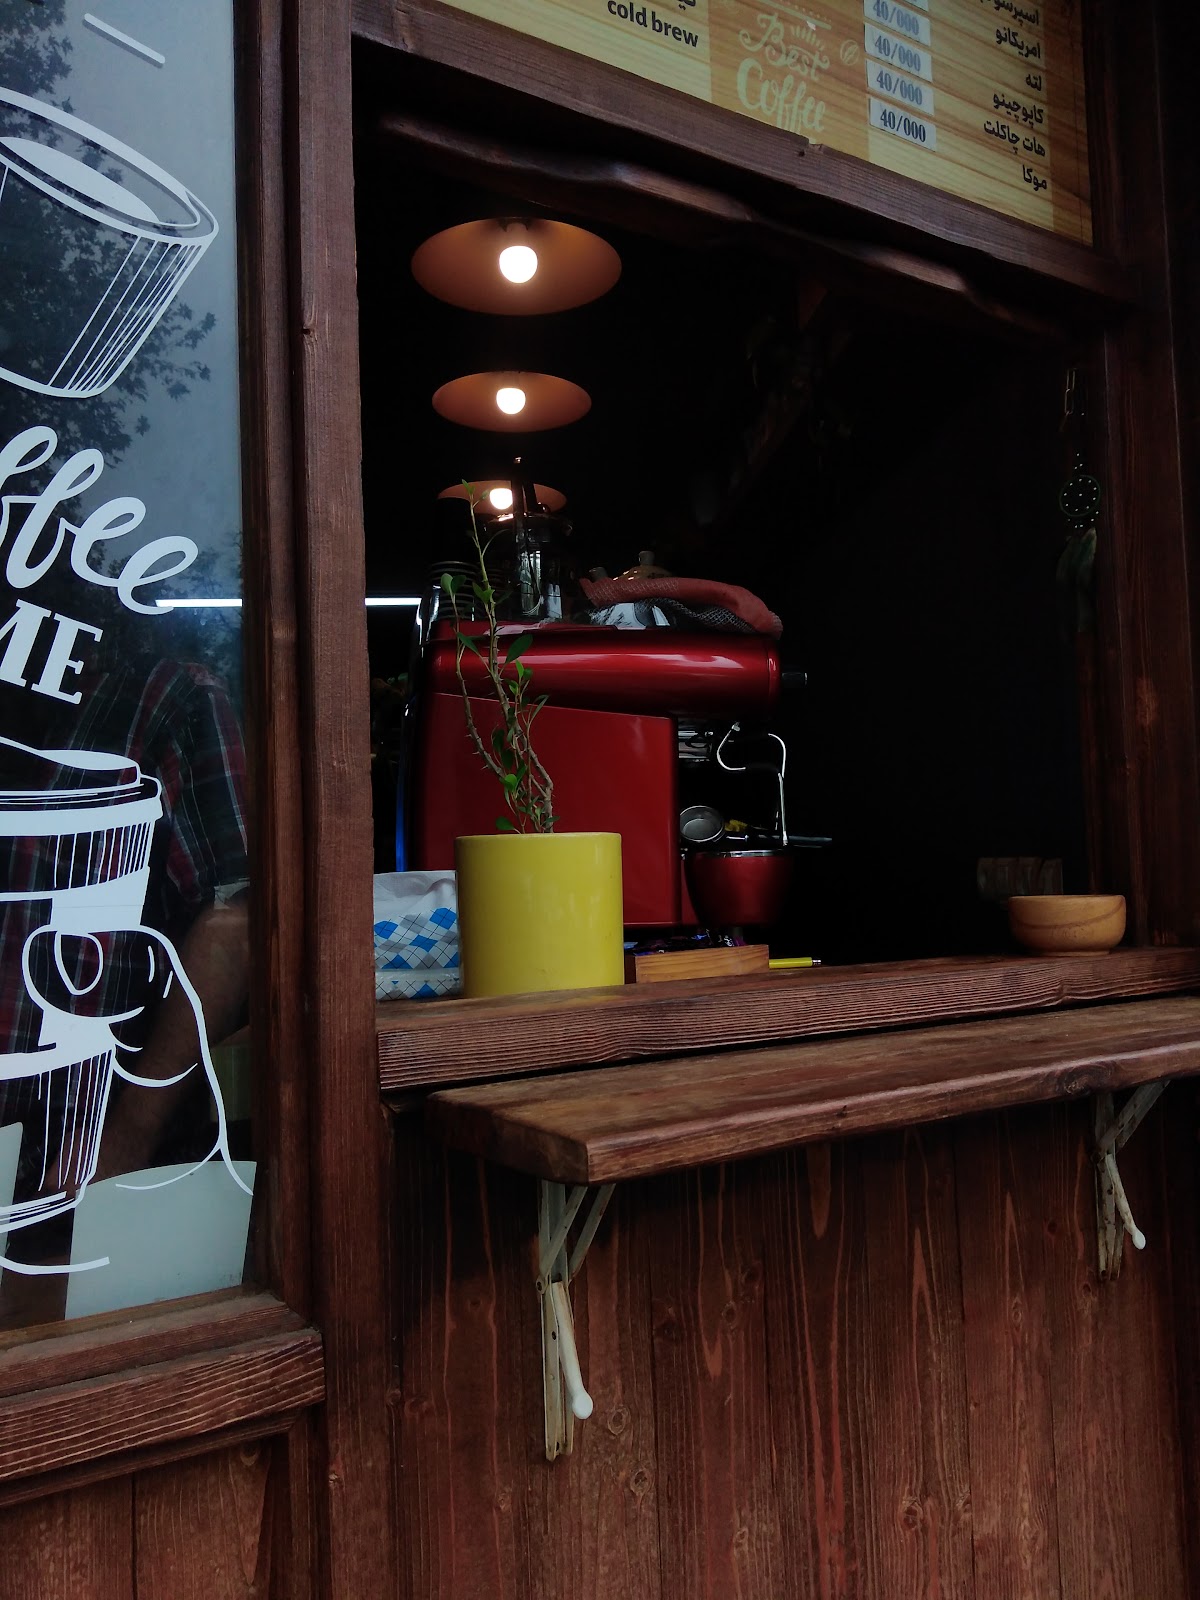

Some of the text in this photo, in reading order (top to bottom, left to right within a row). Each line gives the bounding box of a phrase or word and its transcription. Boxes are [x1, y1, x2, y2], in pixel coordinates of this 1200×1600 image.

[607, 0, 699, 48] cold brew
[873, 0, 920, 35] 40/000
[738, 12, 830, 81] Best
[874, 35, 922, 72] 40/000
[995, 26, 1041, 59] امریکانو
[737, 57, 826, 133] Coffee
[876, 69, 923, 106] 40/000
[1025, 73, 1042, 92] لته
[880, 107, 926, 143] 40/000
[993, 92, 1044, 129] کاپوچینو
[1022, 134, 1046, 158] هات
[1022, 164, 1048, 192] موکا
